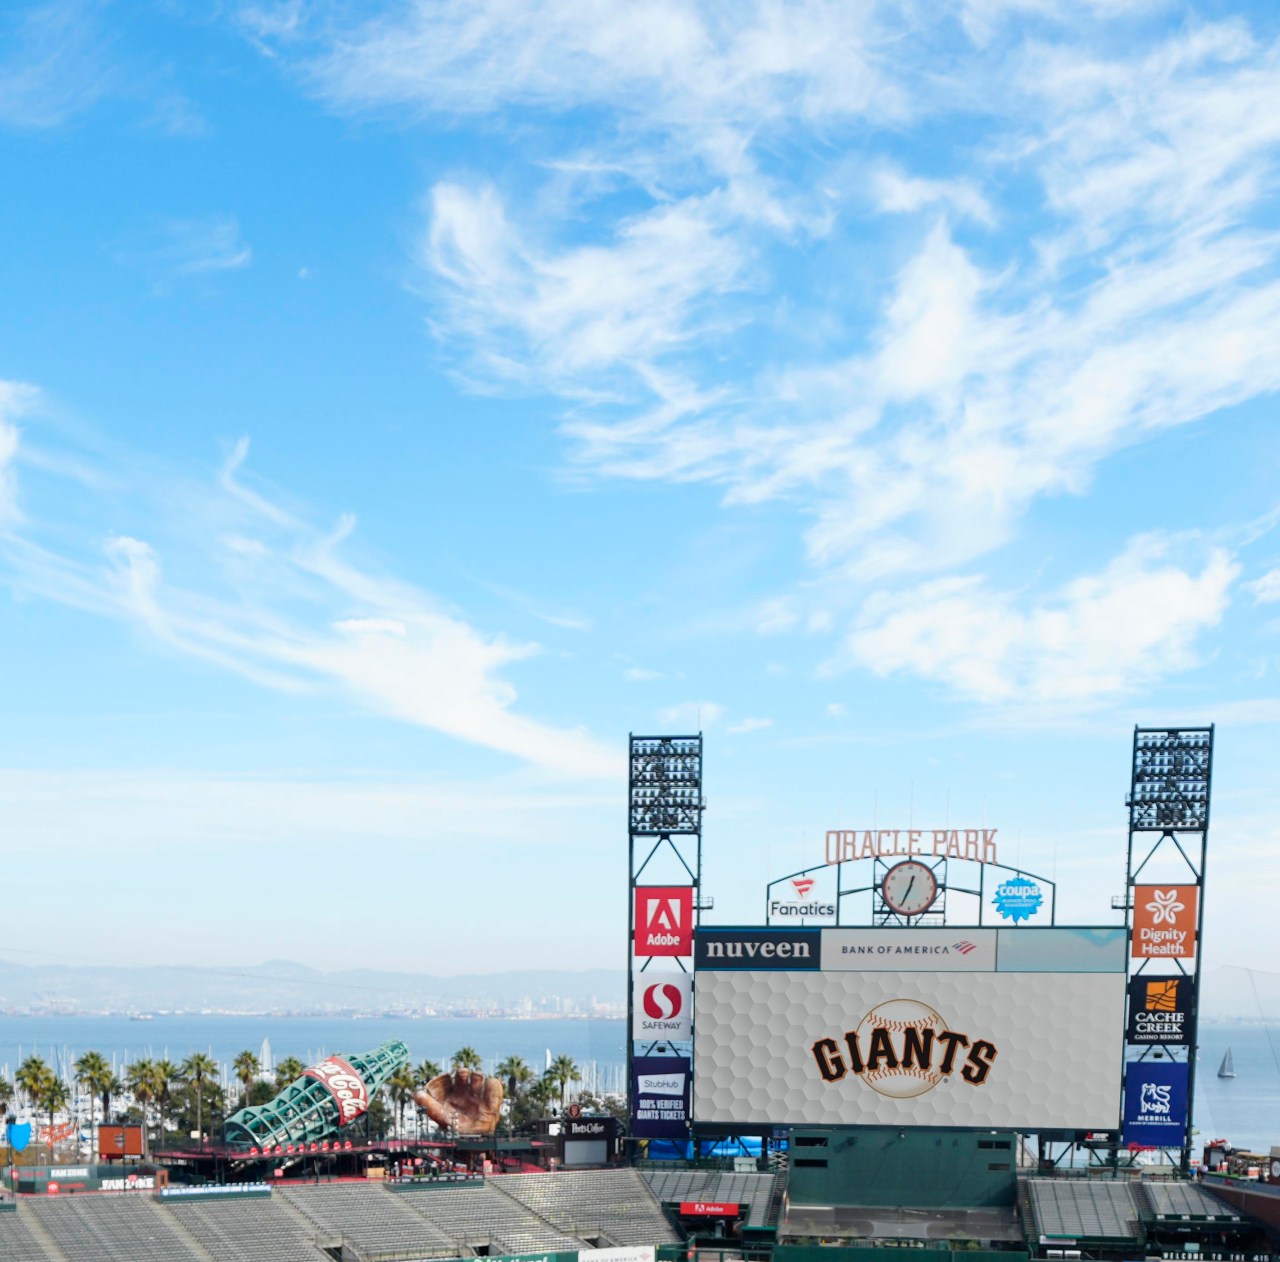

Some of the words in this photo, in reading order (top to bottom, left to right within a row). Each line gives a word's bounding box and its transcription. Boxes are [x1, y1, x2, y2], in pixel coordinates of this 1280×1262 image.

[825, 830, 922, 865] ORACLE
[932, 829, 999, 865] PARK
[1000, 885, 1040, 899] coupa
[771, 902, 835, 917] Fanatics
[647, 934, 680, 946] Adobe
[1140, 928, 1187, 943] Dignity
[706, 941, 810, 957] nuveen
[842, 945, 873, 954] BANK
[878, 945, 892, 954] OF
[895, 944, 949, 954] AMERICA
[1142, 943, 1184, 954] Health
[1135, 1012, 1184, 1022] CACHE
[642, 1021, 682, 1030] SAFEWAY
[1136, 1023, 1183, 1033] CREEK
[811, 1027, 998, 1086] GIANTS
[644, 1080, 679, 1088] StubHub
[657, 1100, 684, 1110] VERIFIED
[637, 1110, 659, 1121] GIANTS
[660, 1110, 686, 1121] TICKETS
[589, 1122, 605, 1133] Coffee
[1163, 1252, 1204, 1261] WELCOME
[1212, 1253, 1222, 1261] TO
[1253, 1254, 1269, 1262] 415
